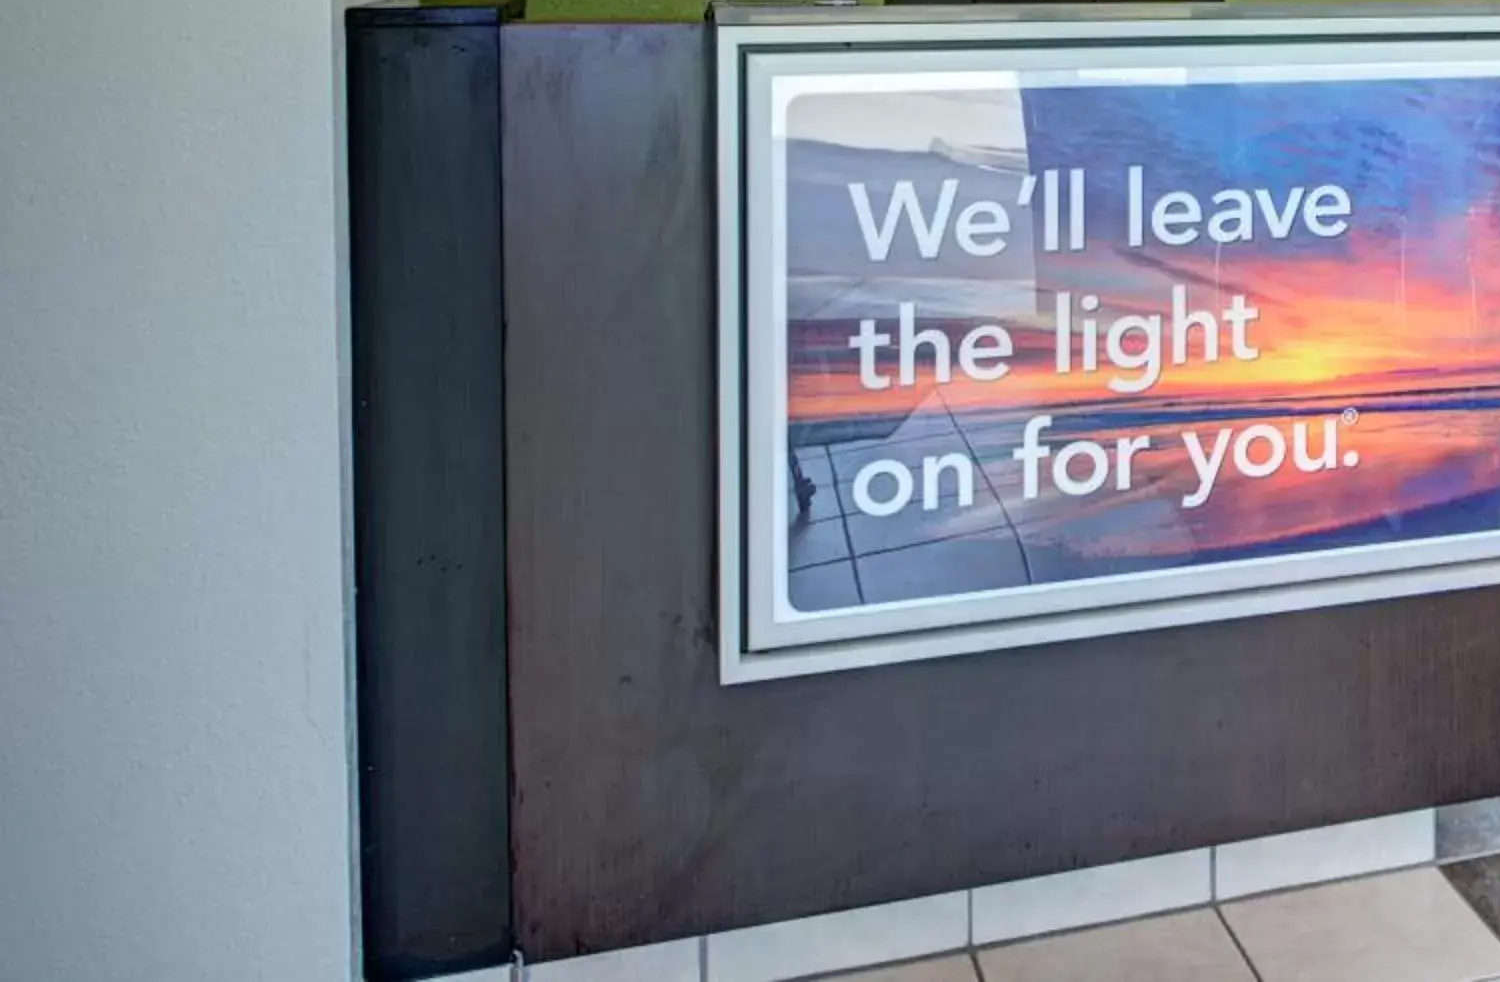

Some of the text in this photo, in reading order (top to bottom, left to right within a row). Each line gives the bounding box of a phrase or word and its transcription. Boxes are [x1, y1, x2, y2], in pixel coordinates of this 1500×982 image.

[848, 165, 1352, 262] We'll leave
[849, 284, 1260, 393] the light
[851, 447, 975, 516] on
[1012, 414, 1150, 500] for
